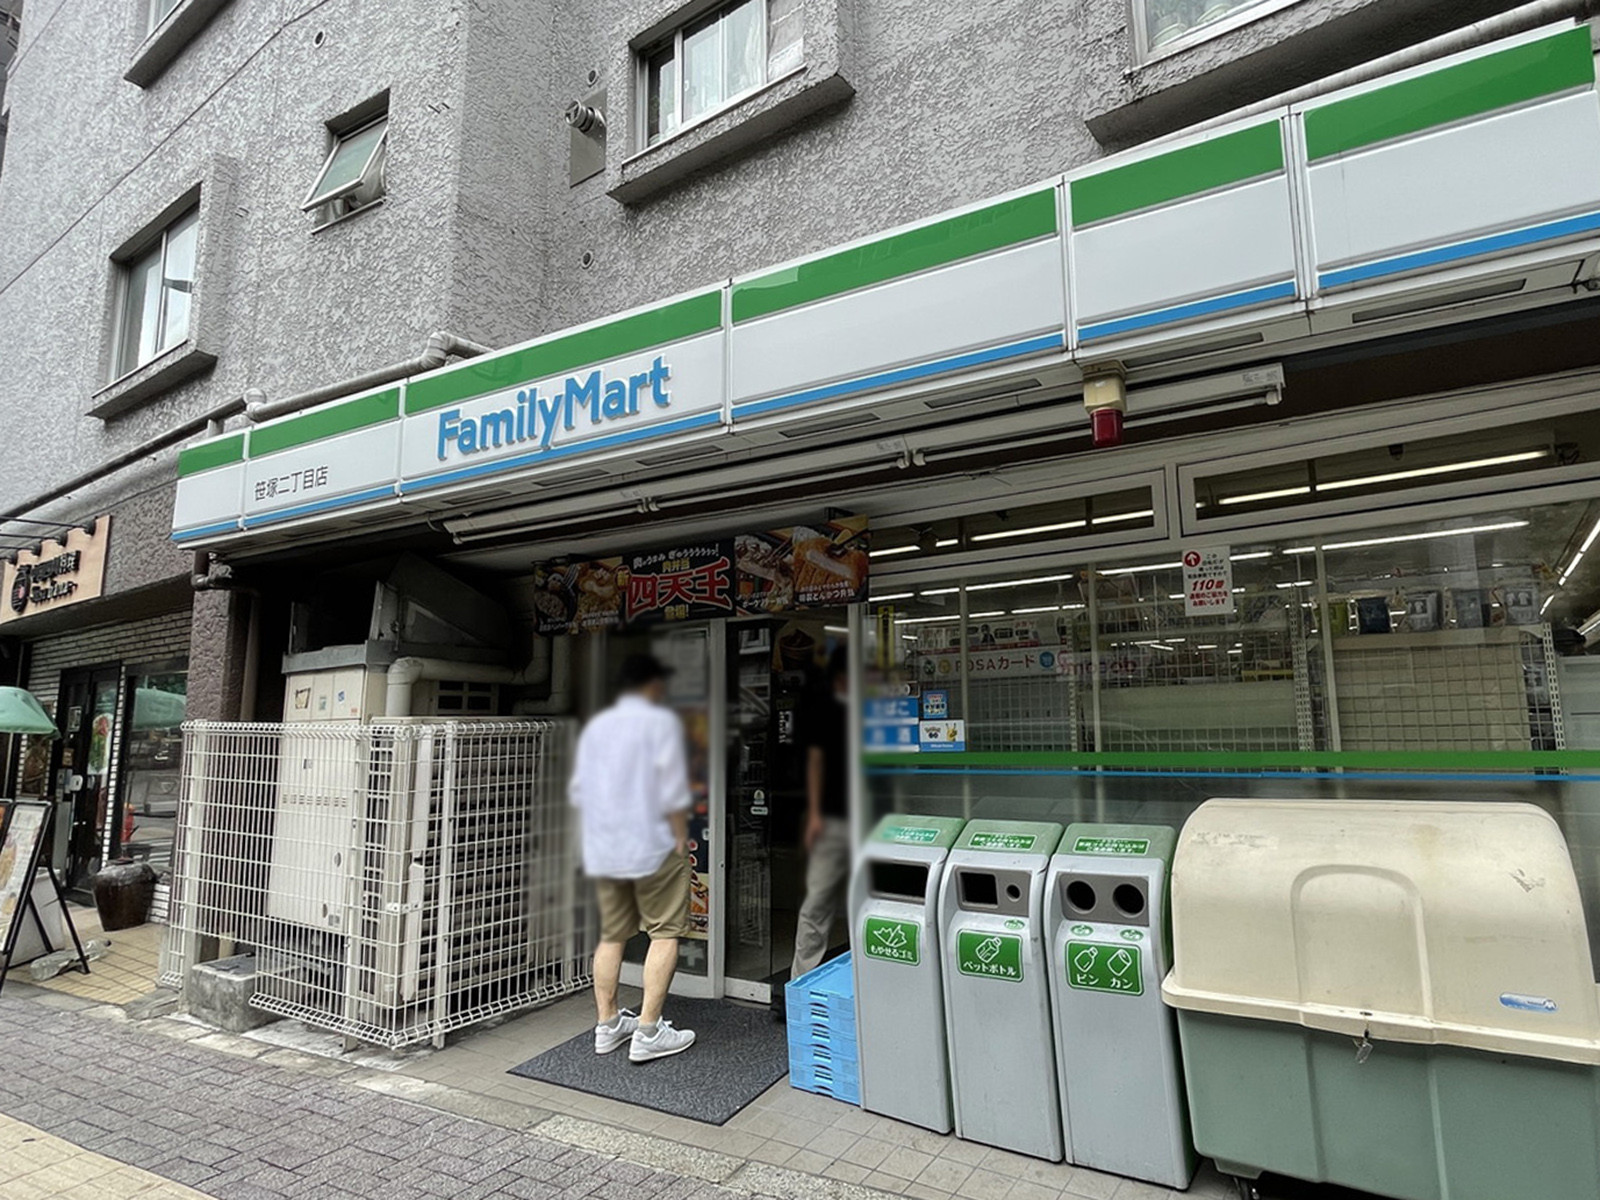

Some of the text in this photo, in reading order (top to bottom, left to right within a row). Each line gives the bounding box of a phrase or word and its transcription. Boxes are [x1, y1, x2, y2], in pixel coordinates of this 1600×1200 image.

[437, 356, 671, 461] FamilyMart
[254, 466, 328, 501] 笹塚二丁目店
[626, 556, 733, 622] 四天王
[1192, 579, 1225, 591] 110番
[870, 945, 913, 960] もやせるゴミ
[963, 961, 1017, 976] ペットボトル
[1110, 978, 1133, 989] カン
